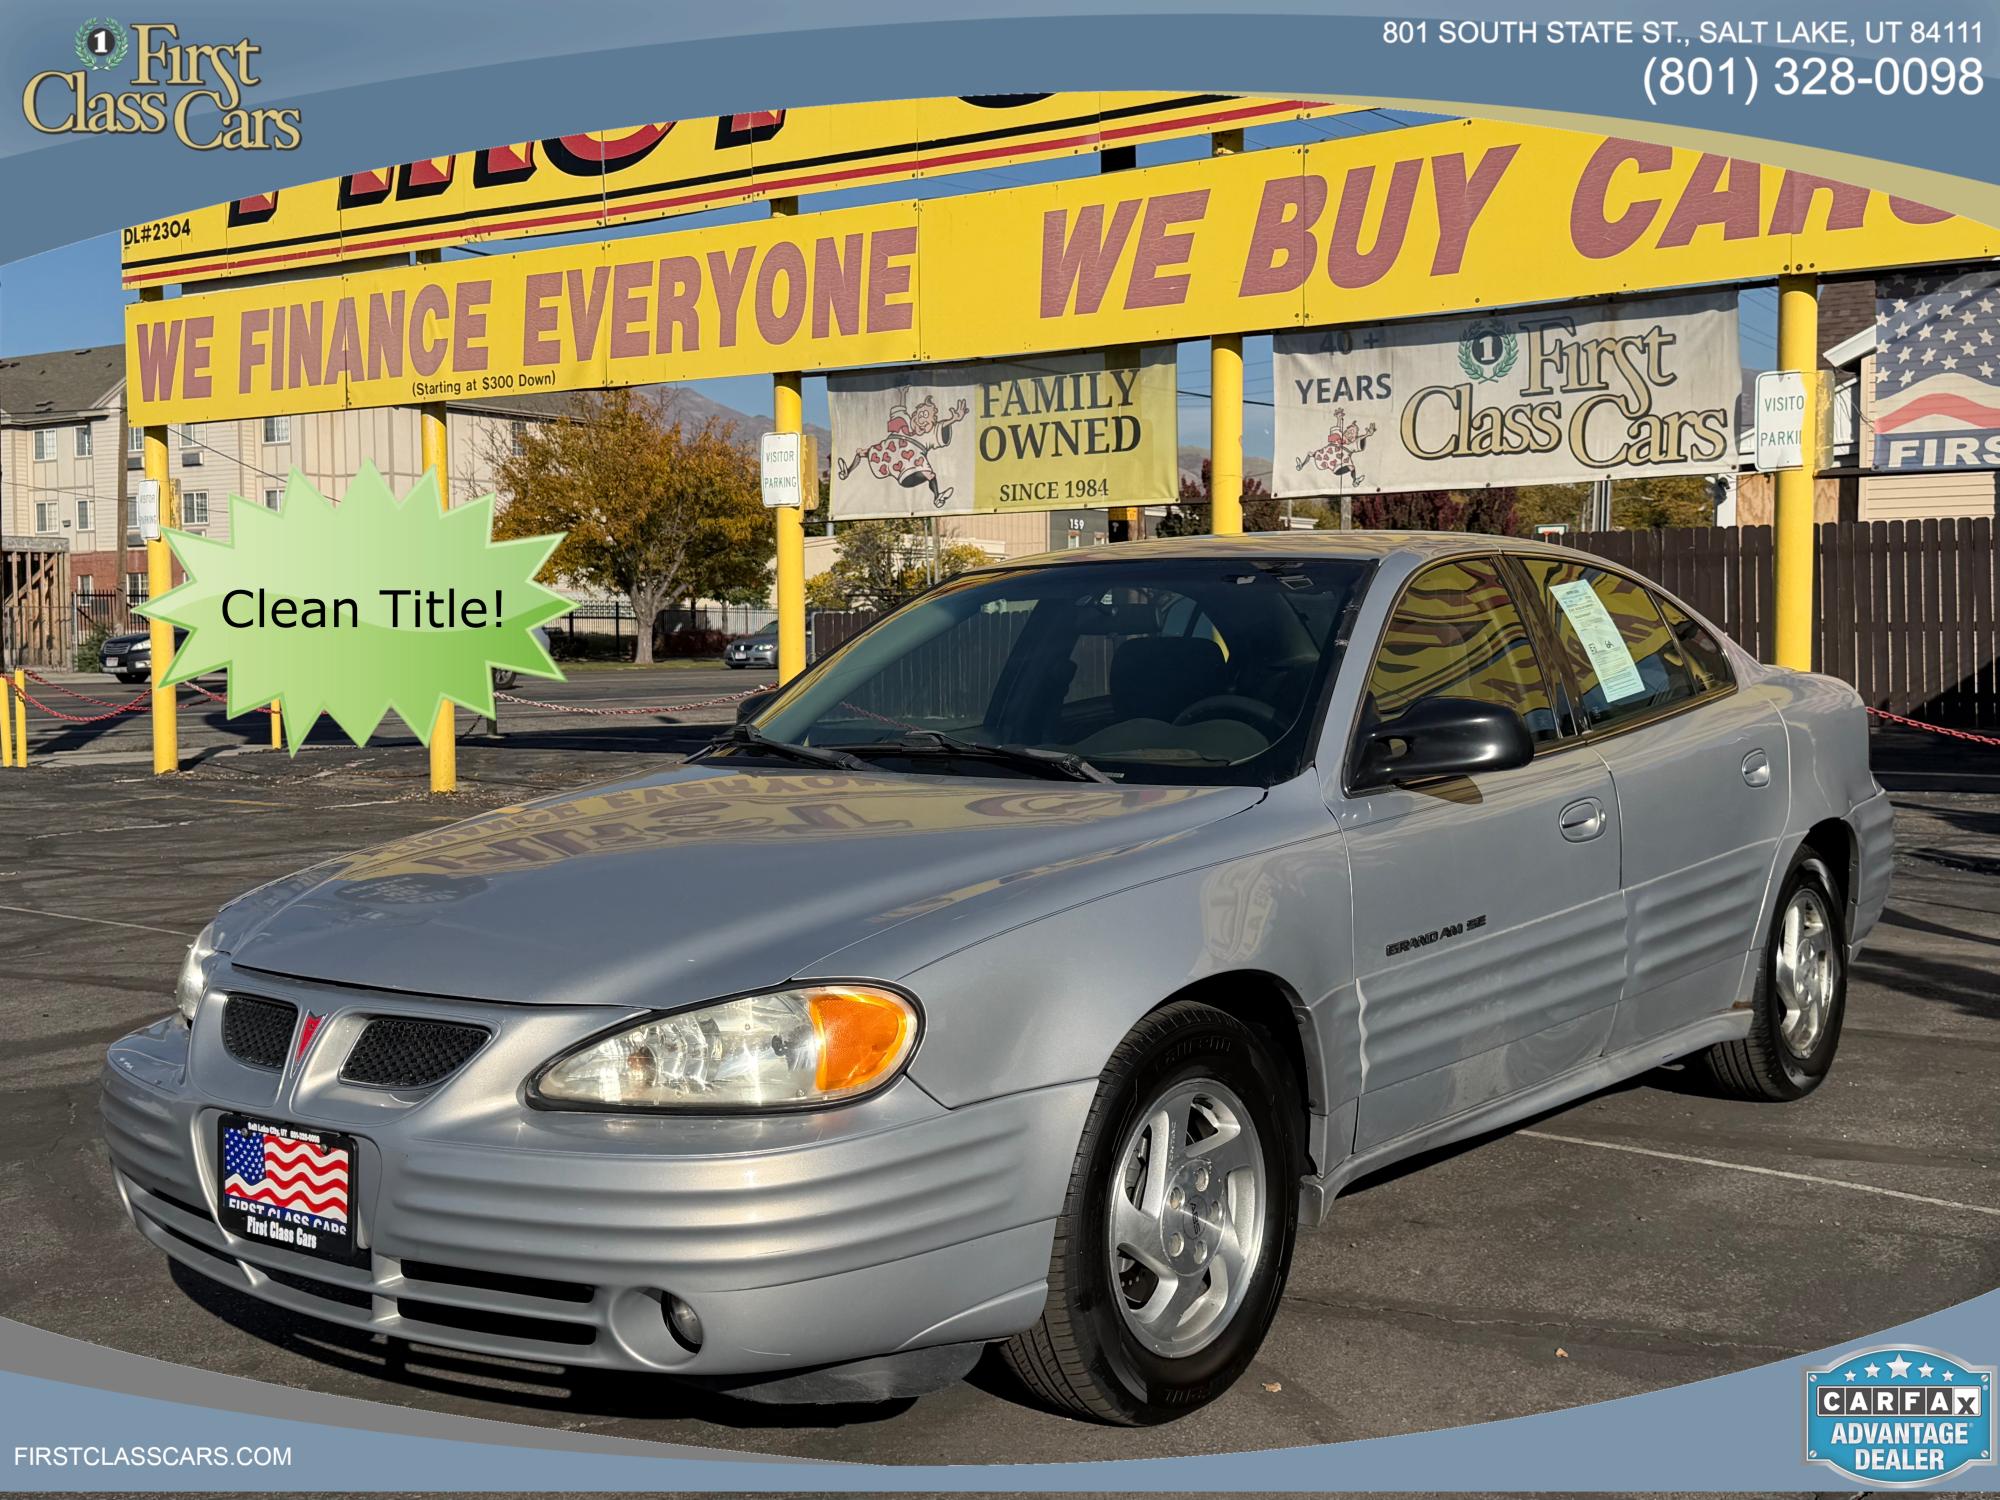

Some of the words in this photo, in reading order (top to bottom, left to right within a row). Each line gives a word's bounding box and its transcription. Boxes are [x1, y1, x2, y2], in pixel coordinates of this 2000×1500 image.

[123, 219, 191, 246] DL#2304
[1040, 188, 1211, 319] WE
[1238, 143, 1522, 298] BUY
[136, 316, 215, 402] WE
[239, 279, 493, 395] FINANCE
[523, 226, 918, 367] EVERYONE
[1320, 330, 1354, 356] 40
[412, 380, 462, 398] (Starting
[465, 378, 478, 392] at
[482, 374, 514, 392] $300
[518, 370, 556, 387] Down)
[1518, 316, 1678, 420] First
[979, 368, 1141, 419] FAMILY
[1295, 373, 1393, 405] YEARS
[1764, 395, 1805, 412] VISITO
[979, 415, 1142, 463] OWNED
[1400, 382, 1562, 461] Class
[1568, 394, 1728, 469] Cars
[766, 450, 794, 463] VISITOR
[764, 476, 797, 489] PARKING
[999, 481, 1059, 502] SINCE
[1065, 478, 1110, 500] 1984
[1069, 518, 1085, 530] 159
[1386, 931, 1439, 956] GRAND
[1440, 923, 1463, 940] AM
[1466, 914, 1487, 931] SE
[247, 1215, 268, 1237] First
[269, 1221, 294, 1244] Class
[296, 1227, 317, 1249] Cars
